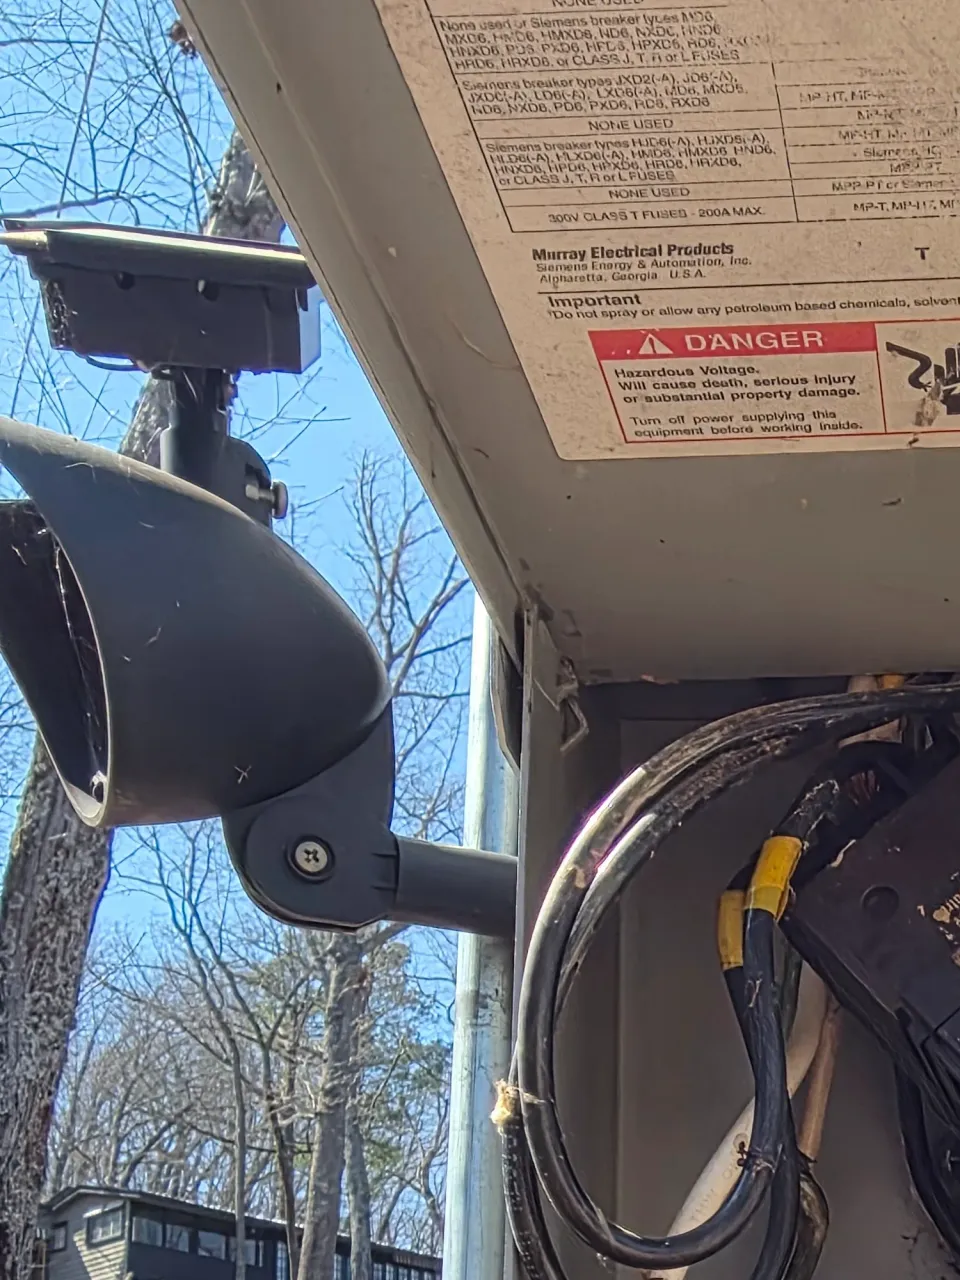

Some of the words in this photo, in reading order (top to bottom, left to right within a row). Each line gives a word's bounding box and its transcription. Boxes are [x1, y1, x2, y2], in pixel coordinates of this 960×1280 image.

[440, 20, 476, 31] None
[530, 16, 588, 28] Siemens
[590, 14, 639, 26] breaker
[588, 120, 630, 130] NONE
[634, 118, 674, 130] USED
[486, 142, 542, 153] Siemens
[544, 140, 592, 152] breaker
[594, 140, 630, 152] types
[514, 174, 560, 186] CLASS
[608, 188, 648, 200] NONE
[651, 187, 691, 198] USED
[583, 211, 628, 222] CLASS
[698, 207, 732, 218] 200A
[532, 248, 586, 262] Murray
[590, 244, 662, 259] Electrical
[667, 242, 734, 256] Products
[536, 262, 588, 272] Siemens
[592, 261, 632, 272] Energy
[650, 257, 724, 270] Automation,
[730, 256, 752, 266] Inc.
[540, 271, 608, 283] Alpharetta,
[612, 270, 658, 282] Georgia
[548, 294, 642, 310] Important
[576, 310, 598, 319] not
[601, 309, 638, 320] spray
[659, 306, 694, 316] allow
[697, 306, 722, 316] any
[725, 303, 792, 316] petroleum
[794, 301, 837, 311] based
[839, 298, 911, 310] chemicals,
[684, 330, 824, 351] DANGER
[614, 367, 695, 379] Hazardous
[699, 364, 760, 378] Voltage.
[618, 380, 646, 391] Will
[652, 380, 697, 390] cause
[702, 378, 748, 390] death,
[753, 375, 810, 386] serious
[814, 374, 857, 386] injury
[623, 395, 640, 404] or
[644, 392, 726, 404] substantial
[730, 388, 793, 402] property
[798, 387, 861, 400] damage.
[629, 416, 662, 426] Turn
[668, 415, 686, 424] off
[692, 414, 734, 426] power
[742, 410, 806, 424] supplying
[812, 409, 837, 420] this
[634, 425, 704, 438] equipment
[710, 424, 754, 436] before
[760, 421, 812, 434] working
[819, 418, 864, 430] inside.
